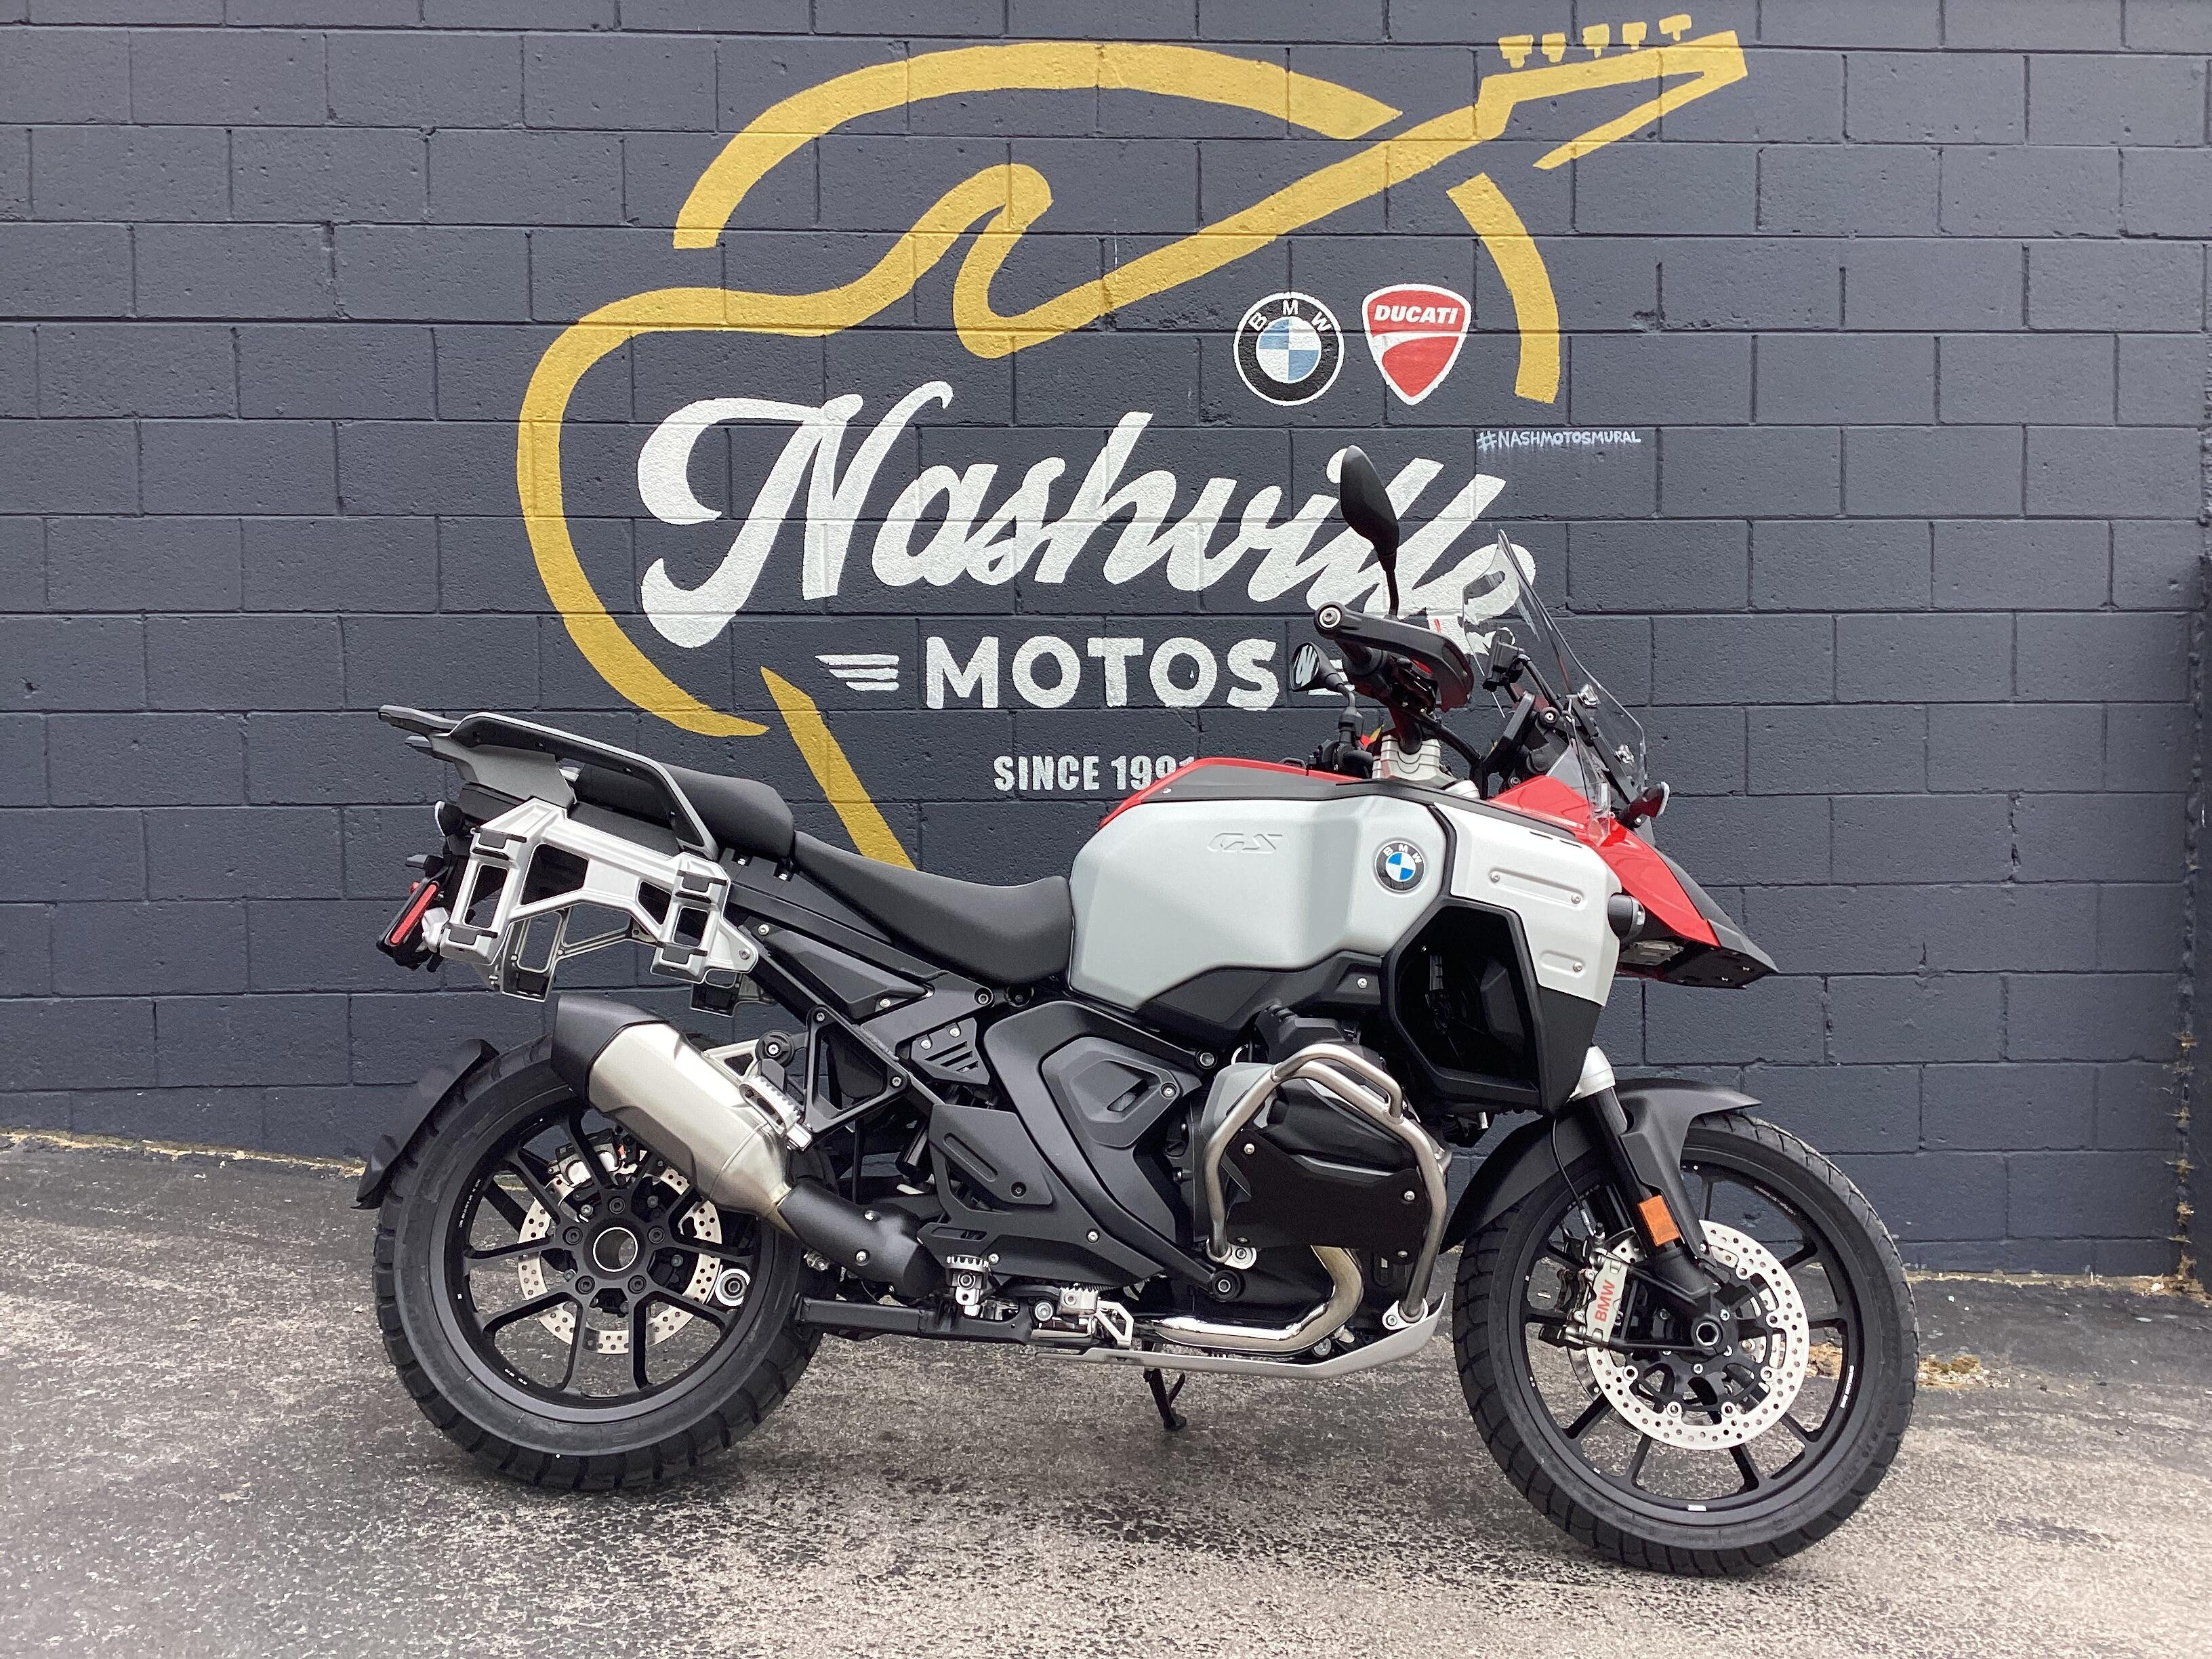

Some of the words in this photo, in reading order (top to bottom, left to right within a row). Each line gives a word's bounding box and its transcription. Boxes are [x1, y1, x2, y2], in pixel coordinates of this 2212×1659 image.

[1248, 300, 1332, 332] BMW
[1374, 304, 1458, 325] DUCATI
[1476, 430, 1641, 451] #NASHMOTOSMURAL
[926, 636, 1279, 711] MOTOS
[994, 755, 1099, 791] SINCE
[1111, 756, 1194, 791] 199
[1206, 832, 1283, 854] GS
[1383, 844, 1422, 863] BMW
[1595, 1279, 1615, 1322] BMW
